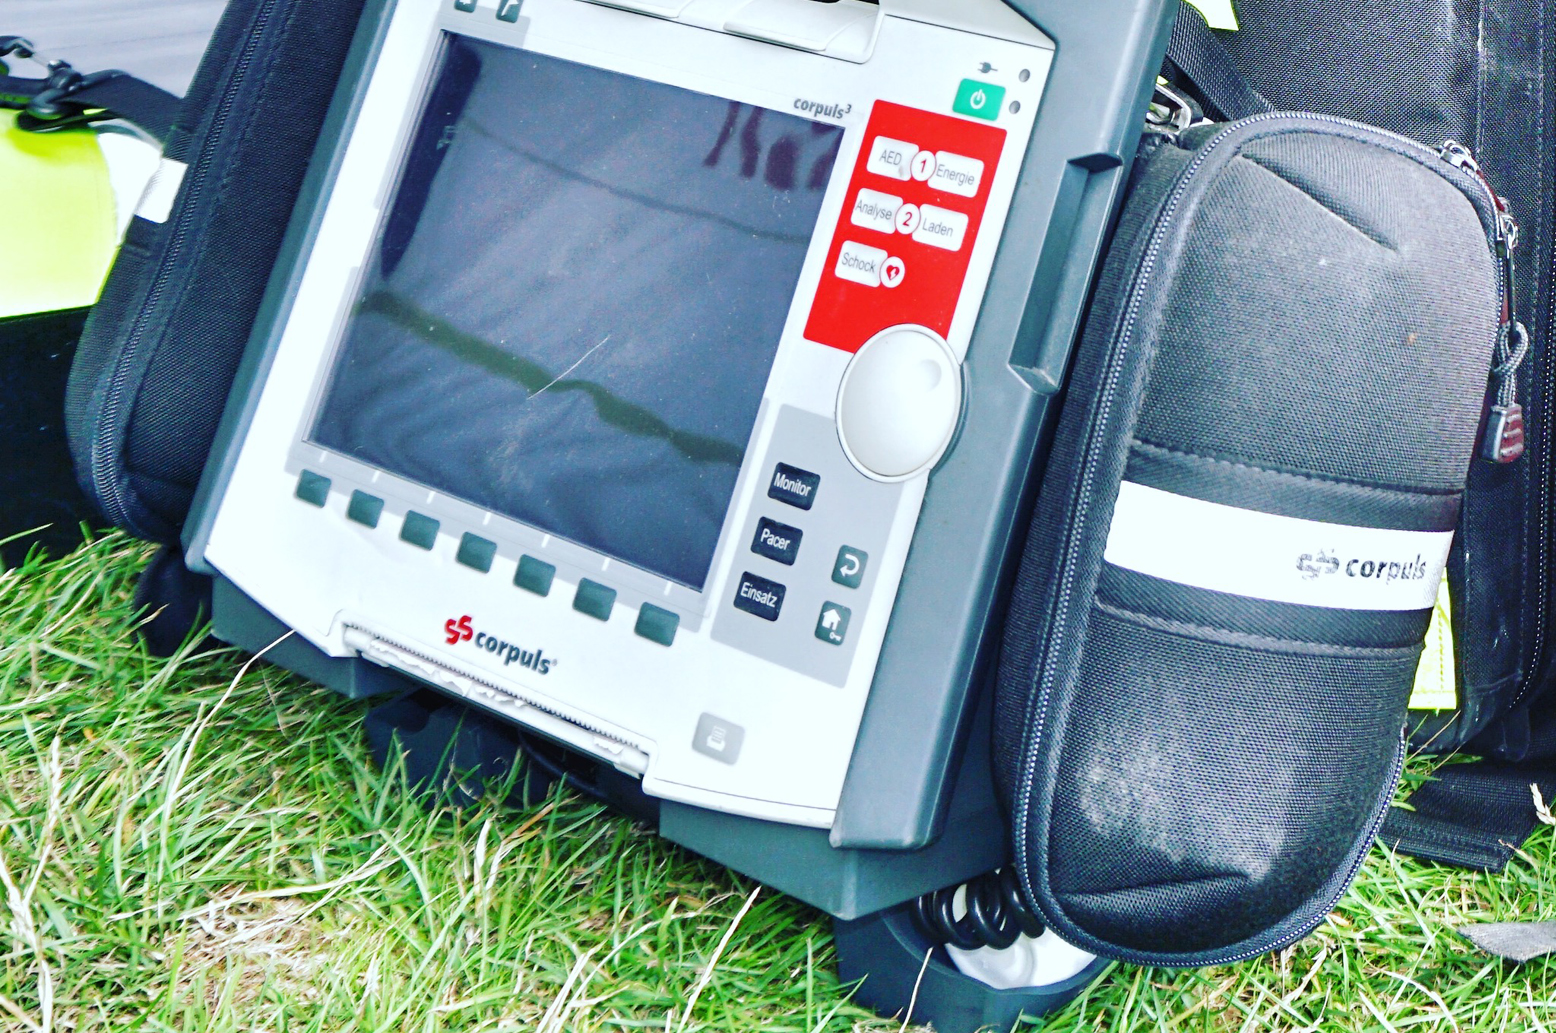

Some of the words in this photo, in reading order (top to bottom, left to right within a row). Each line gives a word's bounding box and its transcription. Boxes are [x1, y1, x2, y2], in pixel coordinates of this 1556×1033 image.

[879, 149, 902, 166] AED
[920, 158, 927, 174] 1
[935, 163, 976, 187] Energie
[855, 199, 893, 221] Analyse
[902, 211, 913, 227] 2
[922, 218, 954, 237] Laden
[841, 252, 877, 274] Schock
[773, 472, 811, 497] Monitor
[760, 528, 791, 551] Pacer
[1345, 553, 1426, 585] corpuls
[740, 582, 778, 608] Einsatz
